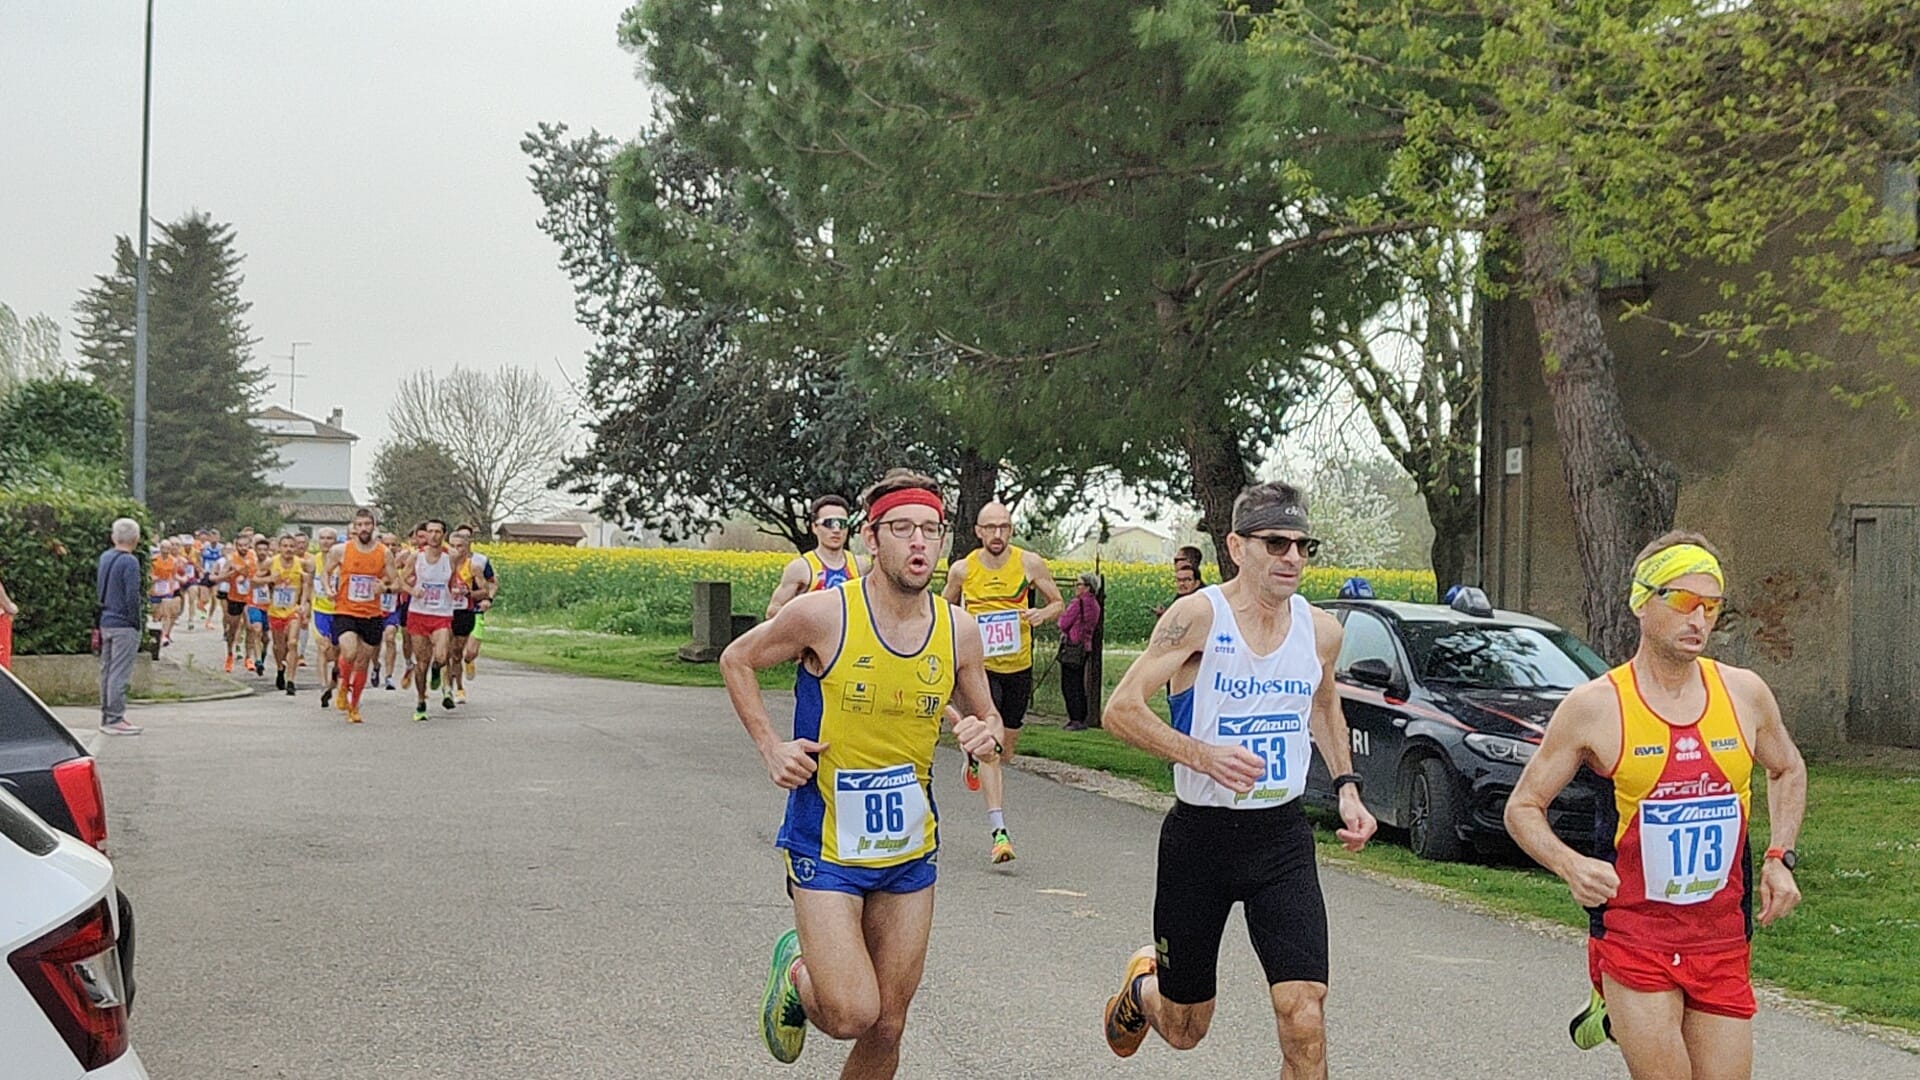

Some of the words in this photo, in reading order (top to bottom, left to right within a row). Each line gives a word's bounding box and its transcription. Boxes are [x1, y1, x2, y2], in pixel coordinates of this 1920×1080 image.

[985, 622, 1014, 645] 254
[1214, 672, 1312, 700] lughesina
[1241, 736, 1287, 782] 53
[865, 791, 904, 833] 86
[1668, 825, 1723, 877] 173
